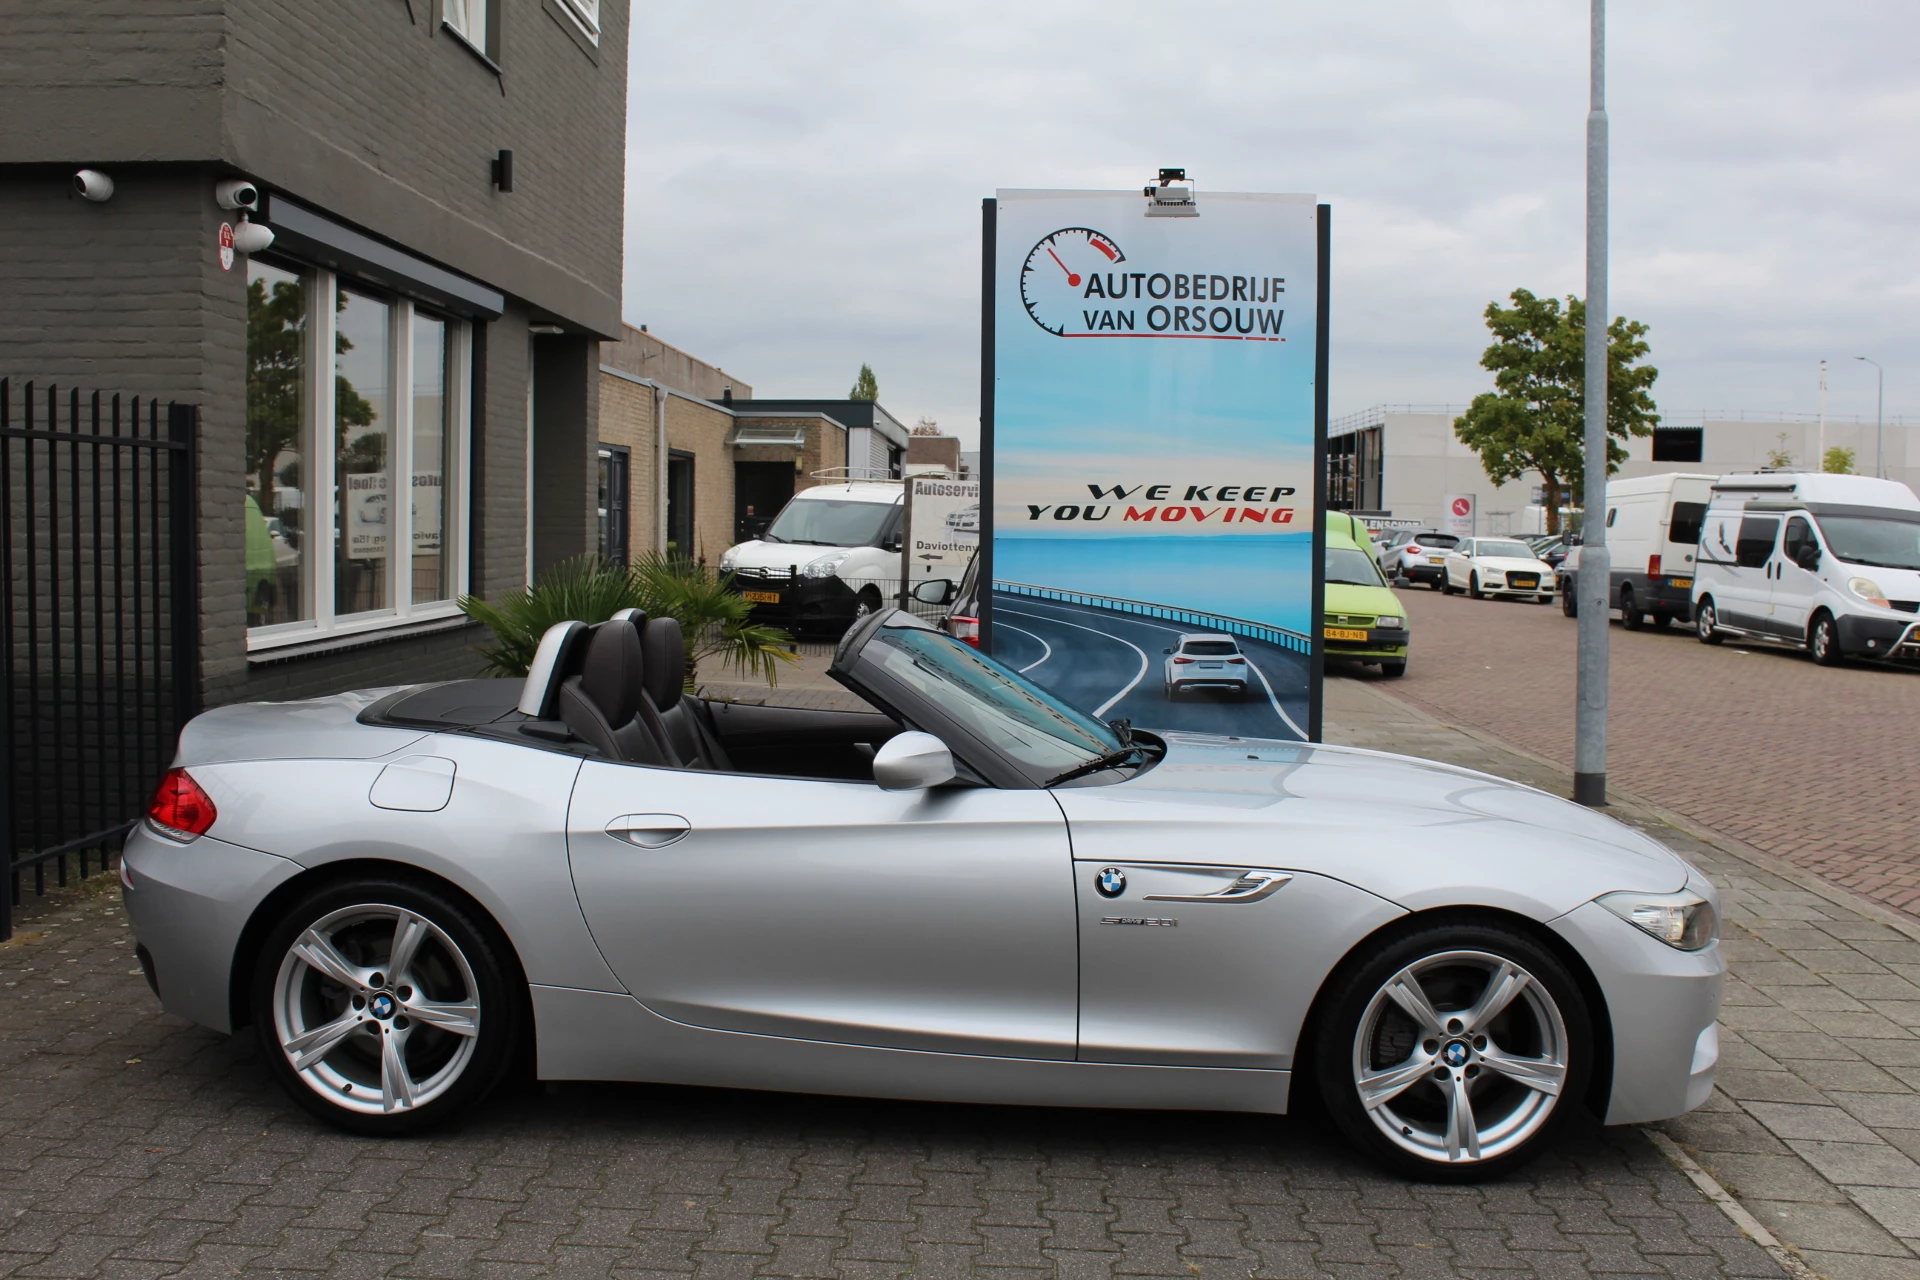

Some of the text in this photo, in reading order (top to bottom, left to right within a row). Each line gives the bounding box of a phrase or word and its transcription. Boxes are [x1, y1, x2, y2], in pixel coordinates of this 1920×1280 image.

[1084, 273, 1286, 303] AUTOBEDRIJF
[1083, 304, 1285, 335] VAN ORSOUW
[1087, 484, 1296, 503] WE KEEP
[1027, 504, 1295, 524] YOU MOVING
